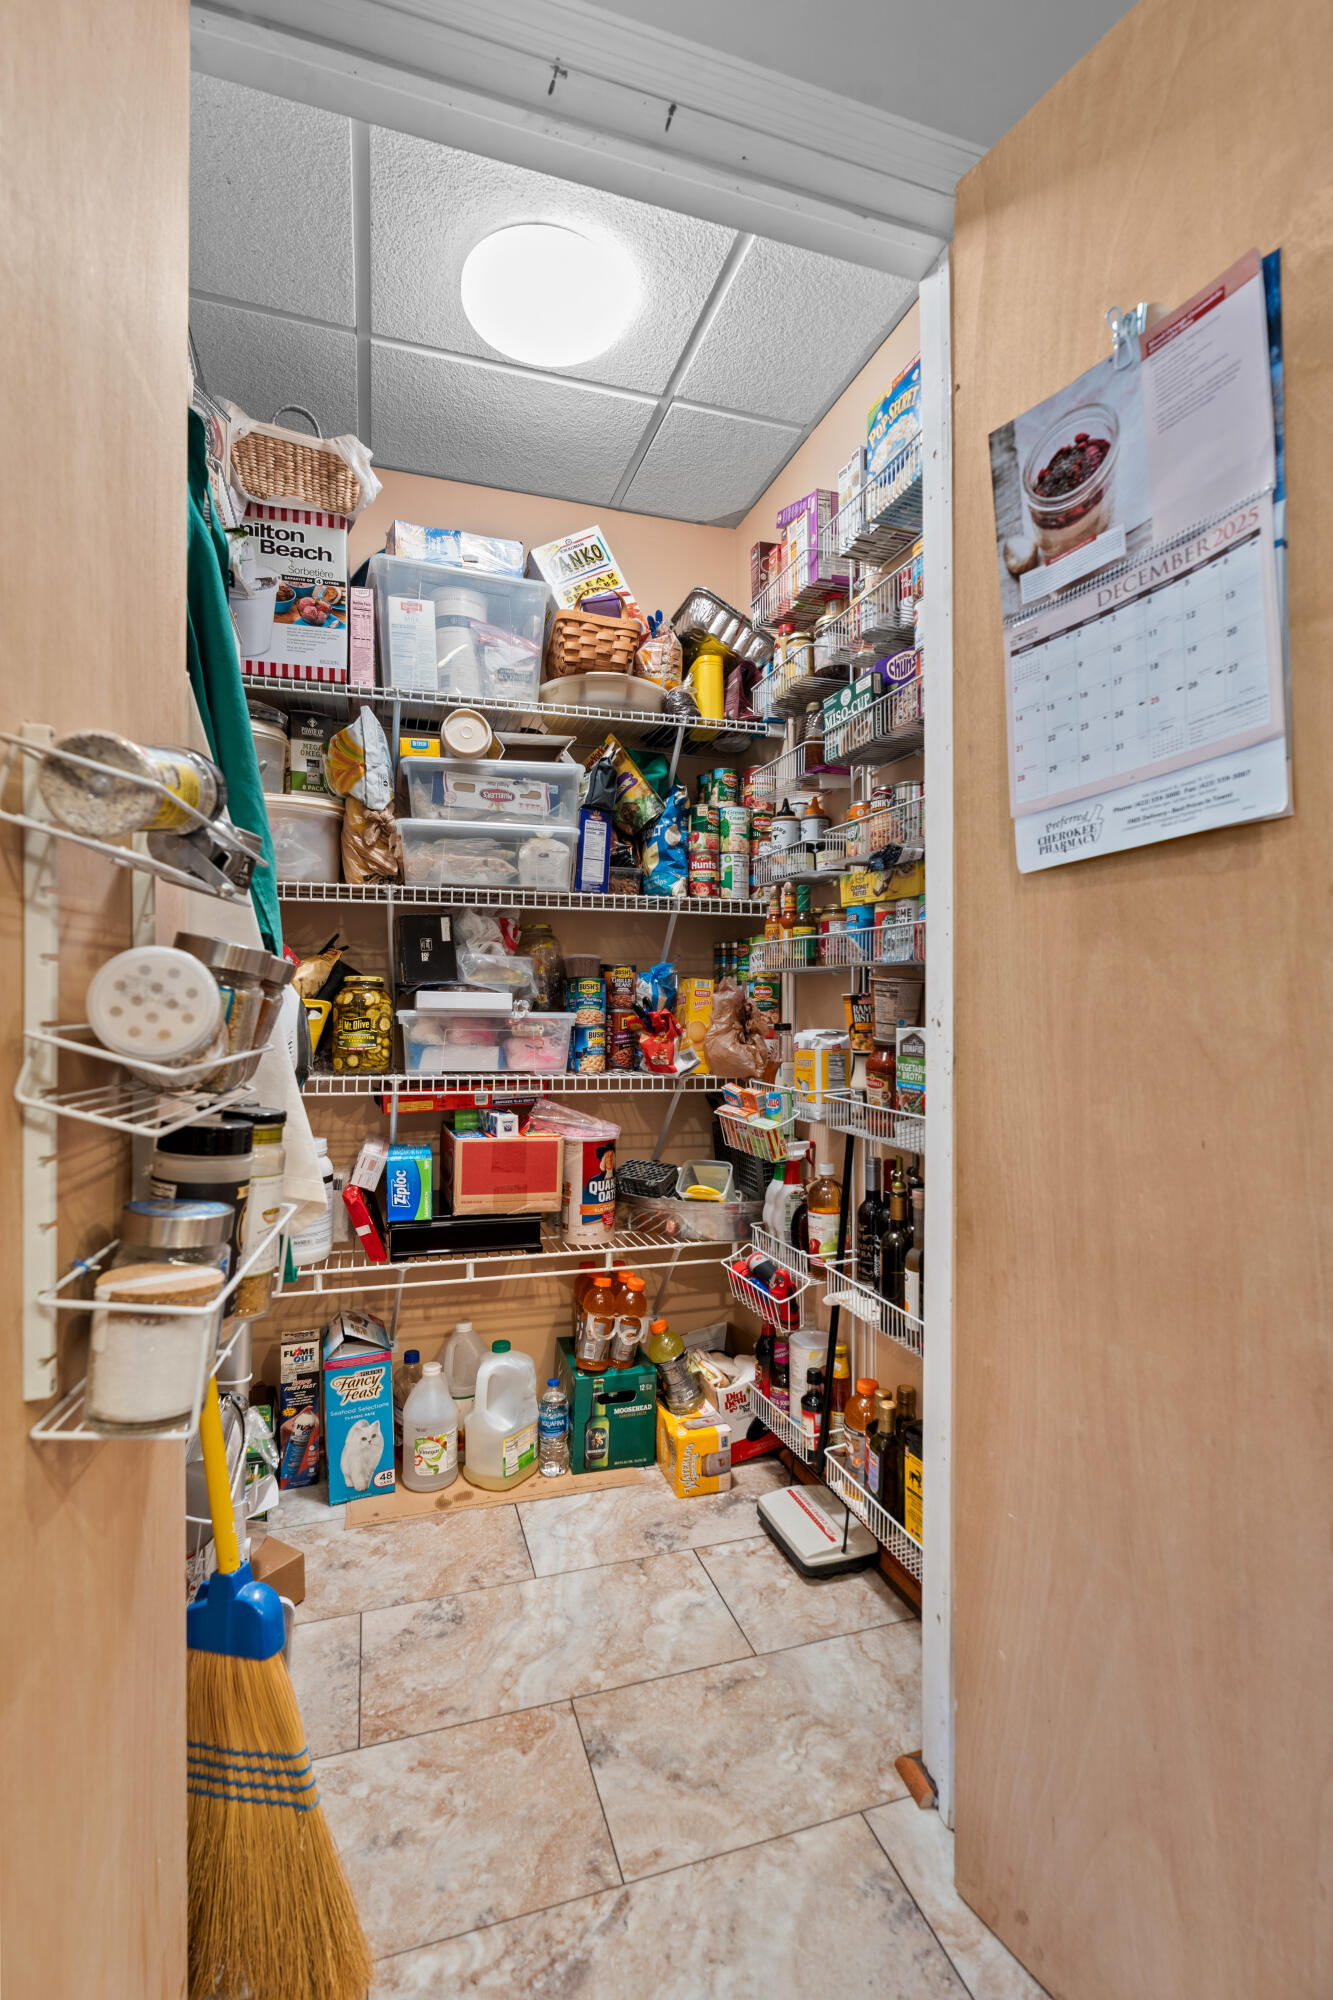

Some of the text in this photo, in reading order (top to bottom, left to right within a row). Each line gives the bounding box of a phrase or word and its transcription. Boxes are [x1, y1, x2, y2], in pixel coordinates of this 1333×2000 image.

[259, 539, 332, 562] Beach
[1097, 538, 1210, 607] DECEMBER
[1212, 506, 1259, 547] 2025
[825, 693, 870, 730] MISO-CUP
[482, 789, 515, 802] MUELLER'S
[1046, 811, 1091, 833] Preferred
[1037, 823, 1095, 846] CHEROKEE
[1039, 833, 1095, 855] PHARMACY
[896, 908, 912, 918] OME
[579, 983, 600, 991] BUSH'S
[853, 1004, 872, 1014] RAM
[344, 1019, 370, 1030] Mt. Olive
[854, 1013, 873, 1023] BIST
[902, 1073, 923, 1081] BROTH
[394, 1169, 410, 1205] Ziploc
[589, 1179, 615, 1196] QUAK
[598, 1190, 615, 1203] OAT
[283, 1346, 315, 1358] FLAME
[293, 1354, 314, 1363] OUT
[360, 1368, 383, 1377] PURINA
[331, 1374, 382, 1393] Fancy
[340, 1384, 383, 1405] Feast
[725, 1390, 743, 1402] Dirt
[724, 1394, 747, 1411] Devil
[329, 1402, 390, 1417] Seafood Selections
[613, 1404, 652, 1415] MOOSEHEAD
[541, 1420, 565, 1429] AQUAFINA
[418, 1447, 440, 1456] Vinegar
[680, 1443, 700, 1491] WATERLOO
[379, 1471, 393, 1481] 48
